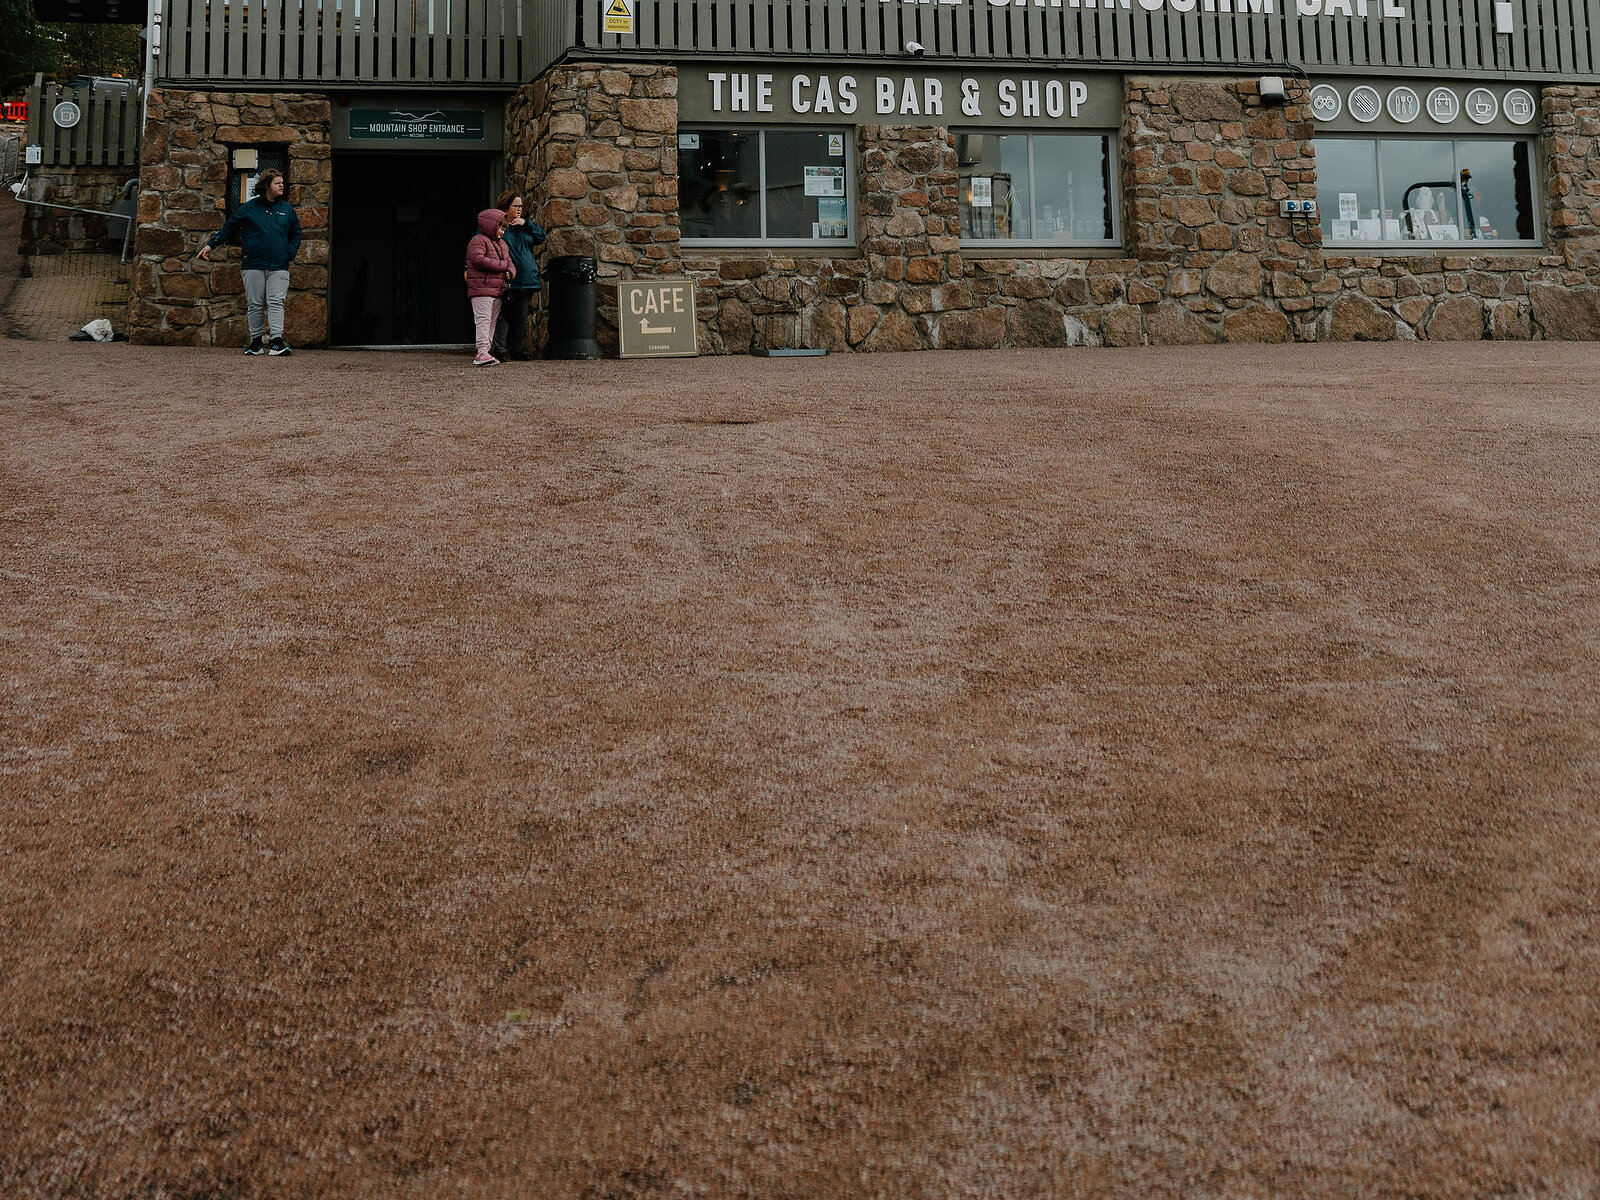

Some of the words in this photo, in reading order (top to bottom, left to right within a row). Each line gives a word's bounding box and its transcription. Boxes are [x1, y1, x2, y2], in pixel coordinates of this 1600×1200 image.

[708, 73, 773, 112] THE
[792, 74, 857, 114] CAS
[876, 76, 943, 115] BAR
[961, 78, 982, 116] &
[999, 79, 1088, 118] SHOP
[369, 123, 407, 133] MOUNTAIN
[408, 123, 428, 133] SHOP
[429, 124, 465, 133] ENTRANCE
[630, 287, 685, 315] CAFE
